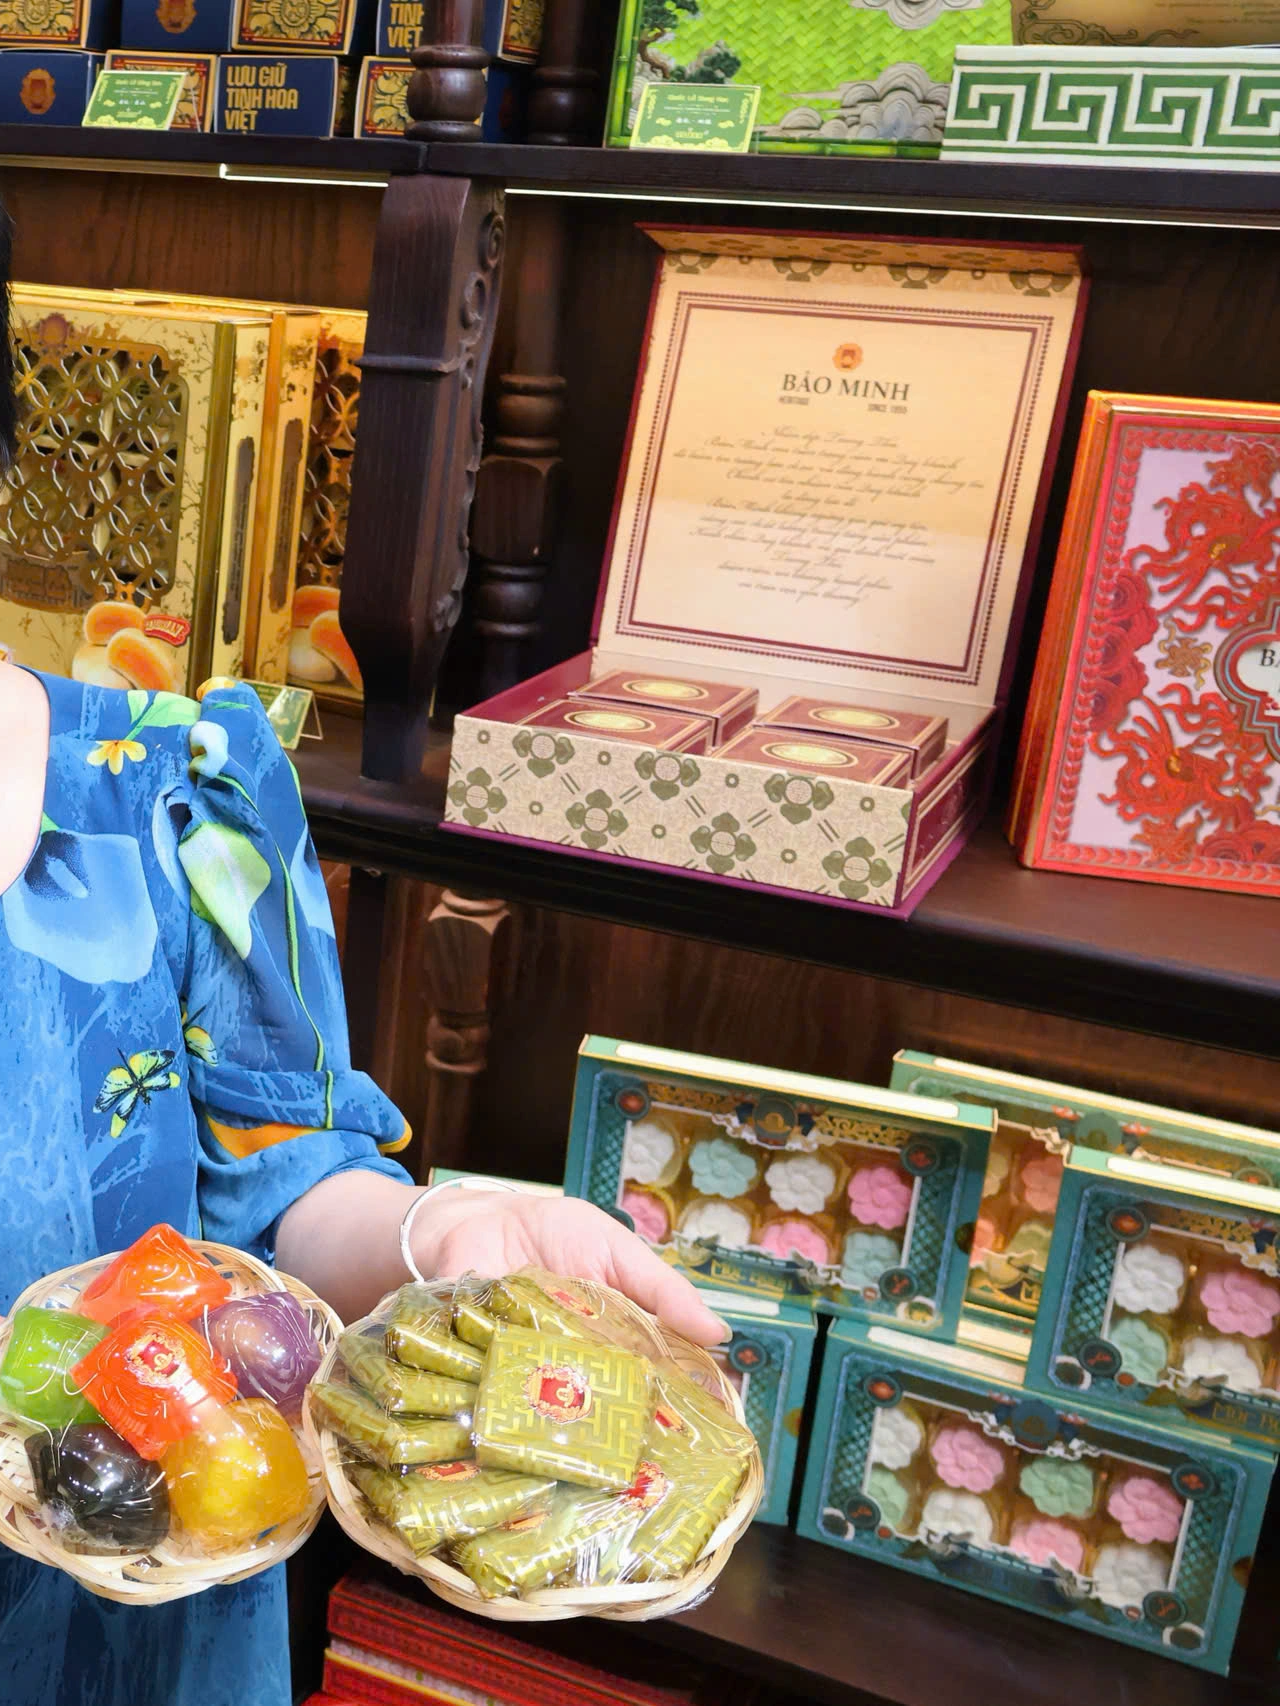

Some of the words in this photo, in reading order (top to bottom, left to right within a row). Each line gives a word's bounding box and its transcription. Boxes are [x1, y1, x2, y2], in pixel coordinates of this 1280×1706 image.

[387, 25, 424, 53] VIỆT
[258, 62, 288, 87] GIỮ
[226, 87, 263, 109] TINH
[264, 88, 299, 110] HOA
[224, 107, 259, 135] VIỆT
[781, 370, 832, 395] BẢO
[839, 377, 911, 401] MINH
